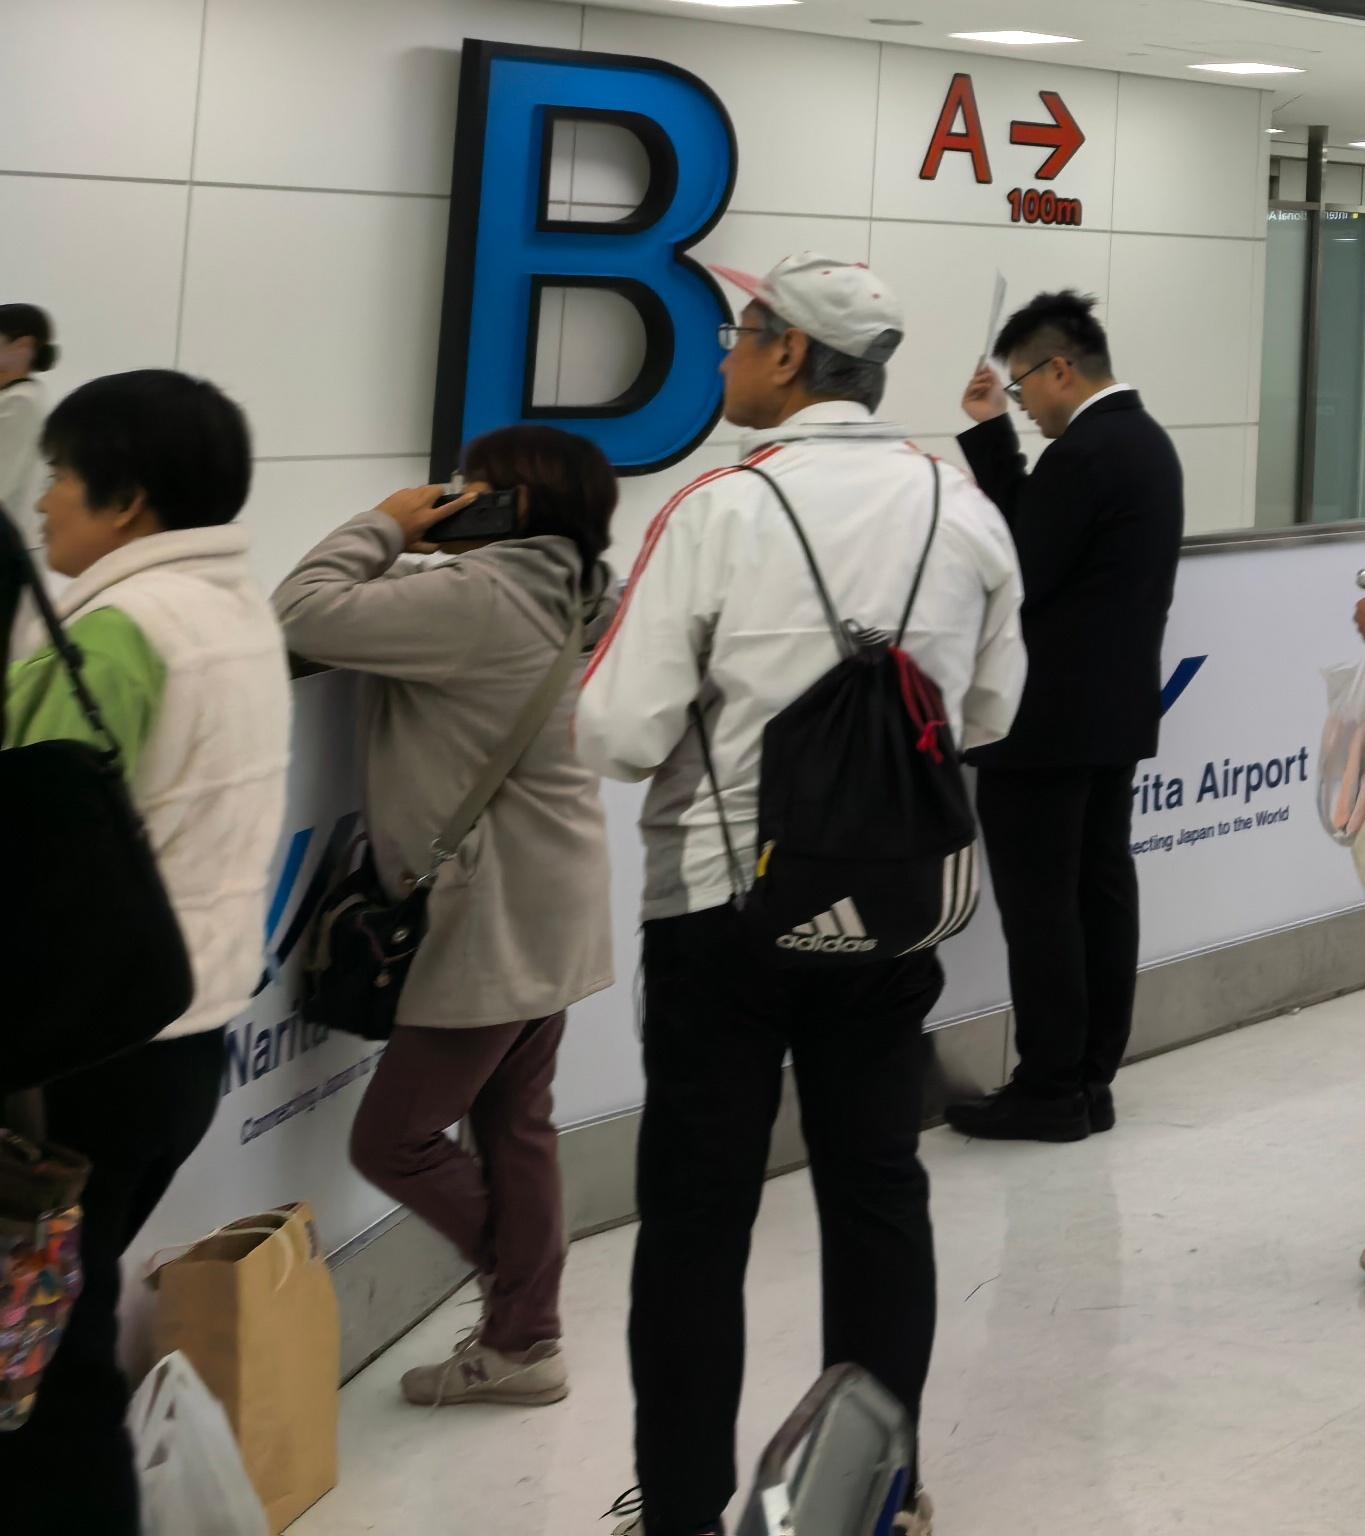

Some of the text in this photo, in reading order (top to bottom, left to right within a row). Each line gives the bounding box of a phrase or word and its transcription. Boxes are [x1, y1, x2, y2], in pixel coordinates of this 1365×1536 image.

[919, 73, 992, 184] A
[1006, 189, 1082, 226] 100m
[429, 38, 738, 480] B
[1129, 744, 1309, 817] rita Airport
[1176, 819, 1214, 847] Japan
[1218, 818, 1231, 834] to
[1233, 812, 1252, 833] the
[1255, 804, 1290, 829] World
[775, 931, 878, 954] adidas
